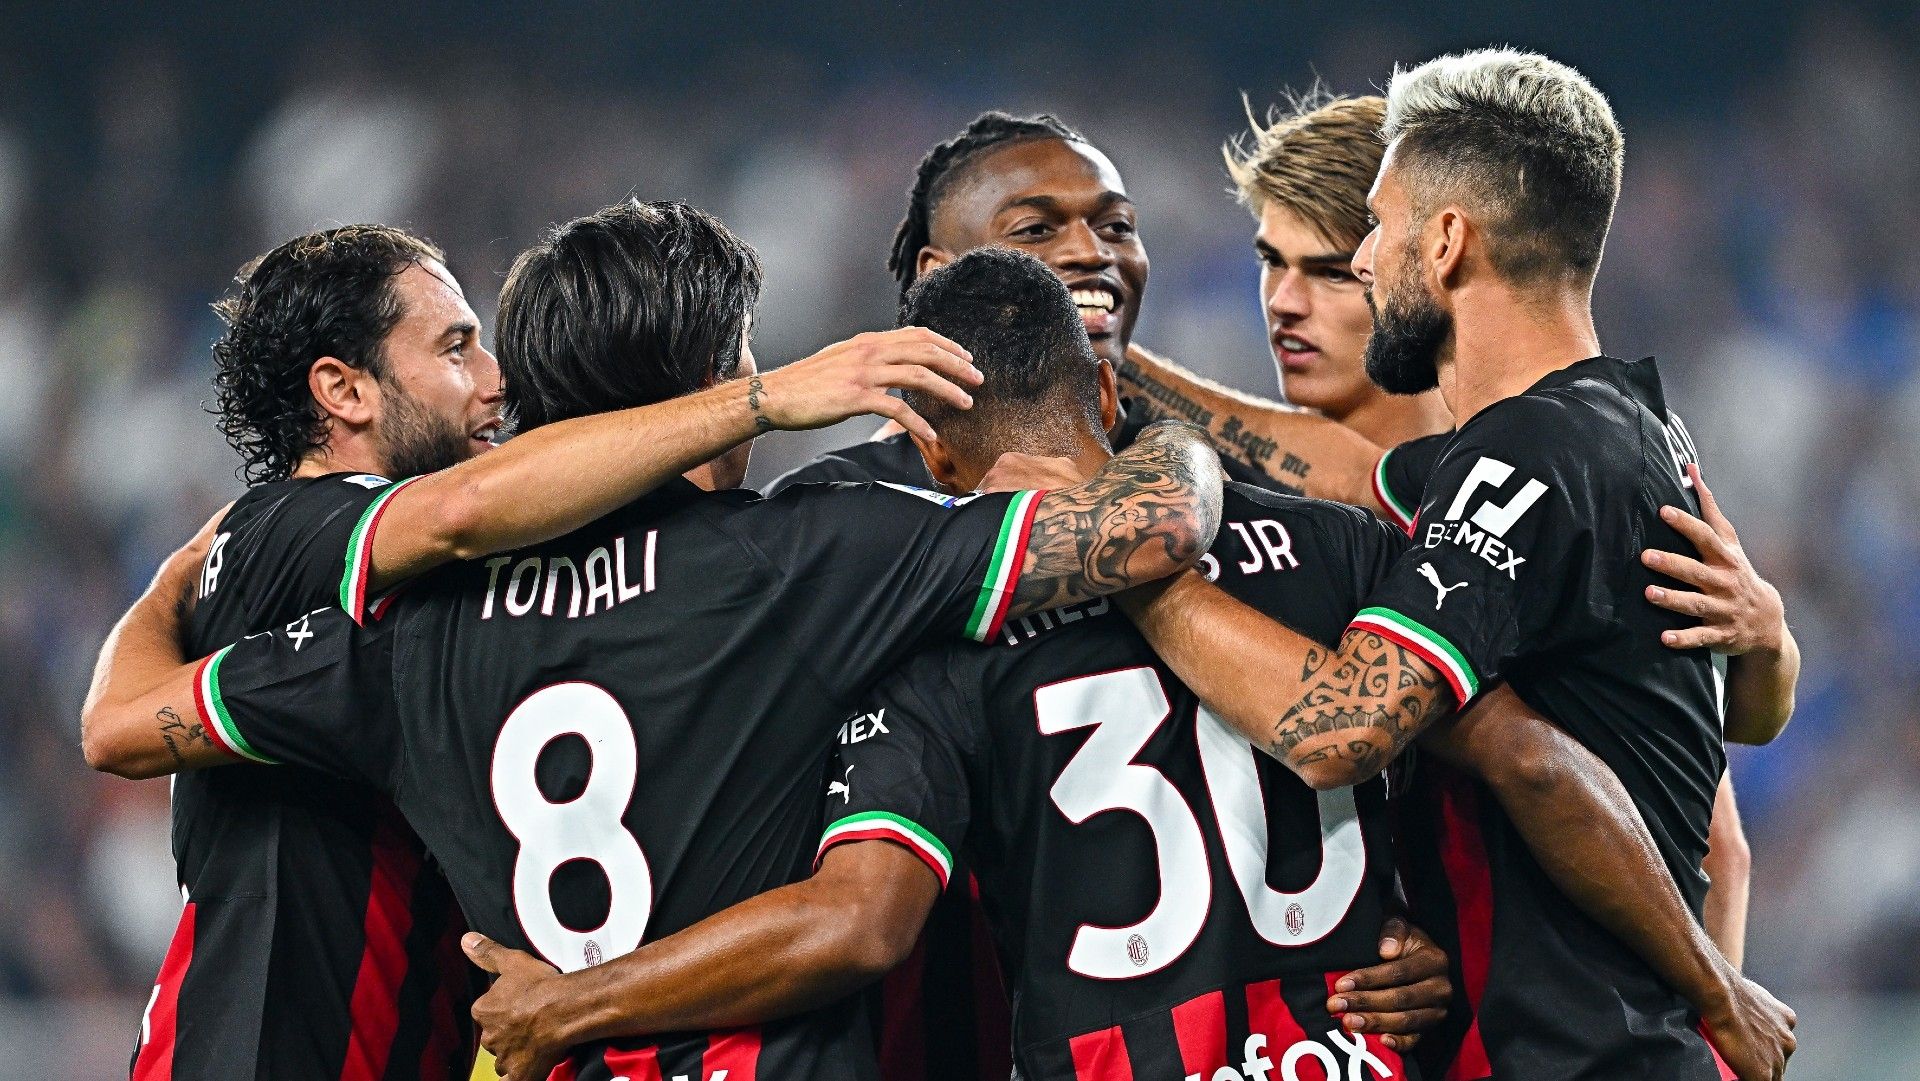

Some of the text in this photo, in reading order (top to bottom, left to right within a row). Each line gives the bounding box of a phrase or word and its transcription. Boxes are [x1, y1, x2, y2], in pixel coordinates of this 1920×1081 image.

[481, 529, 658, 620] TONALI
[1227, 519, 1300, 575] JR
[489, 680, 654, 975] 8
[1033, 666, 1366, 980] 30
